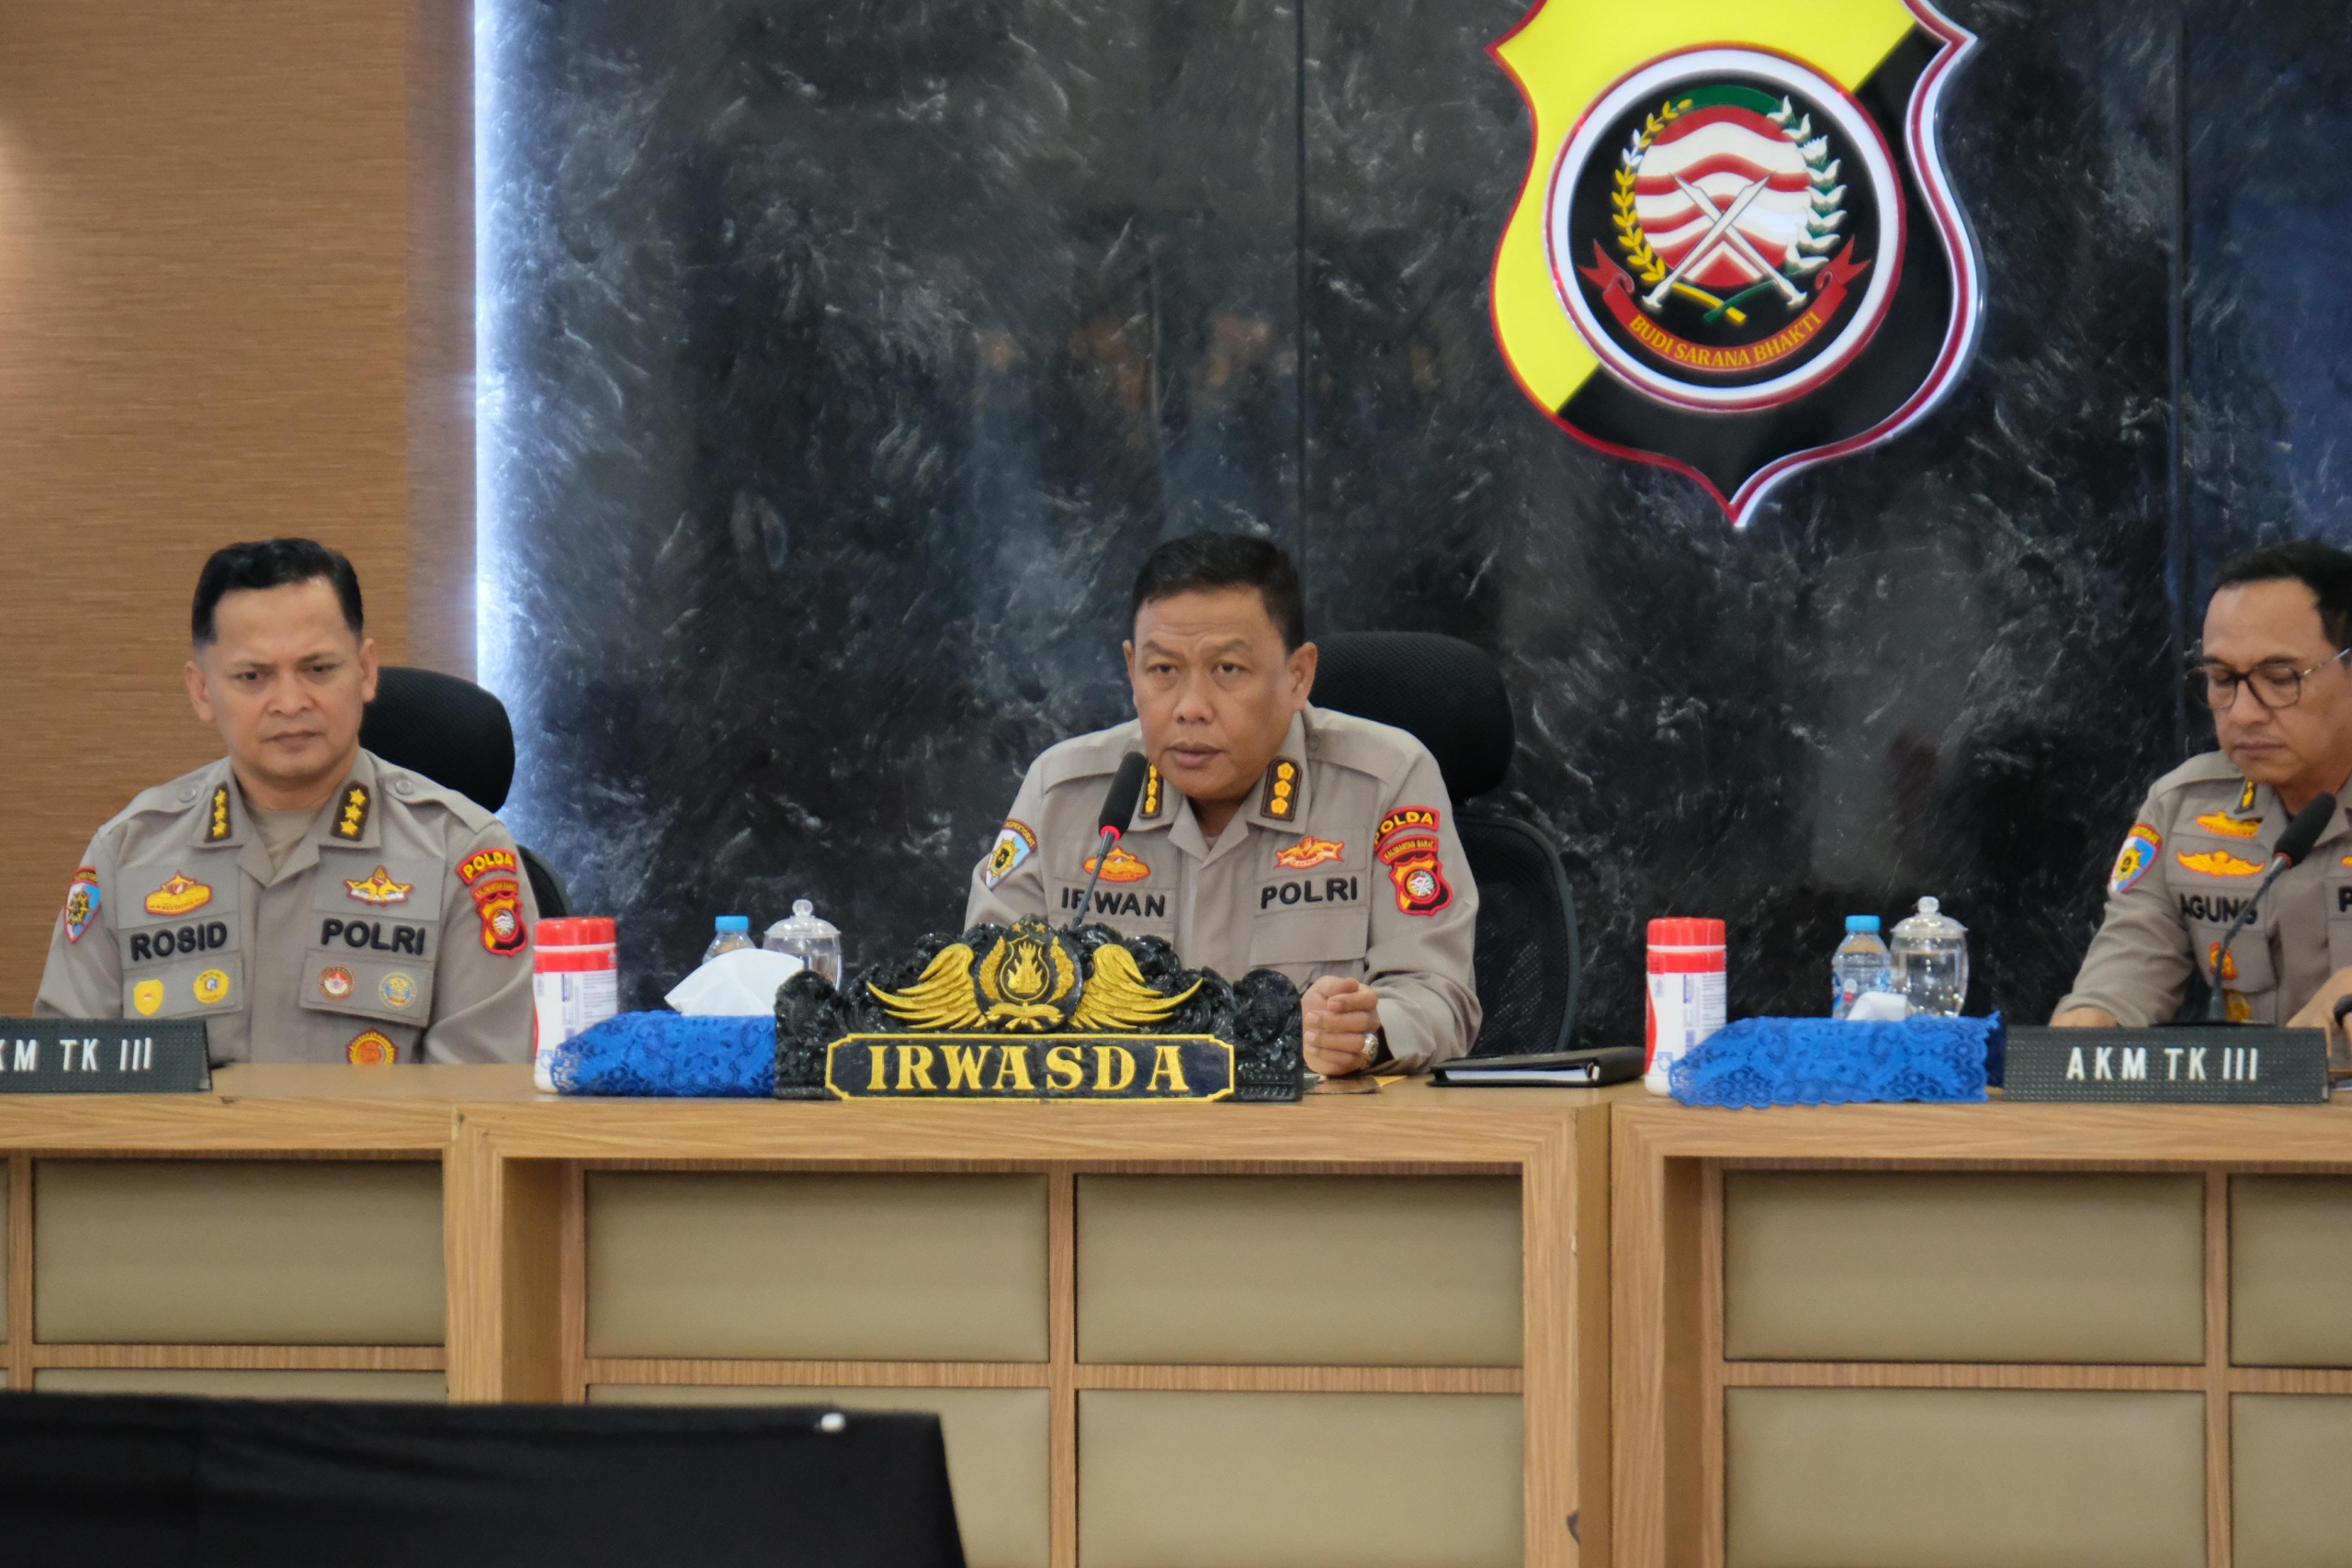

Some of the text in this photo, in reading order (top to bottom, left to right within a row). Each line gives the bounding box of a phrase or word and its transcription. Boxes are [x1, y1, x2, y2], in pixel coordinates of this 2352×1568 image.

[1629, 310, 1822, 367] BUDI SARANA BHAKTI
[463, 852, 514, 879] POLDA
[1261, 875, 1357, 909] POLRI
[130, 920, 228, 962] ROSID
[321, 918, 425, 955] POLRI
[60, 1038, 99, 1071] TK
[119, 1037, 153, 1071] III
[866, 1045, 1190, 1091] IRWASDA
[2066, 1046, 2258, 1080] AKM TK III
